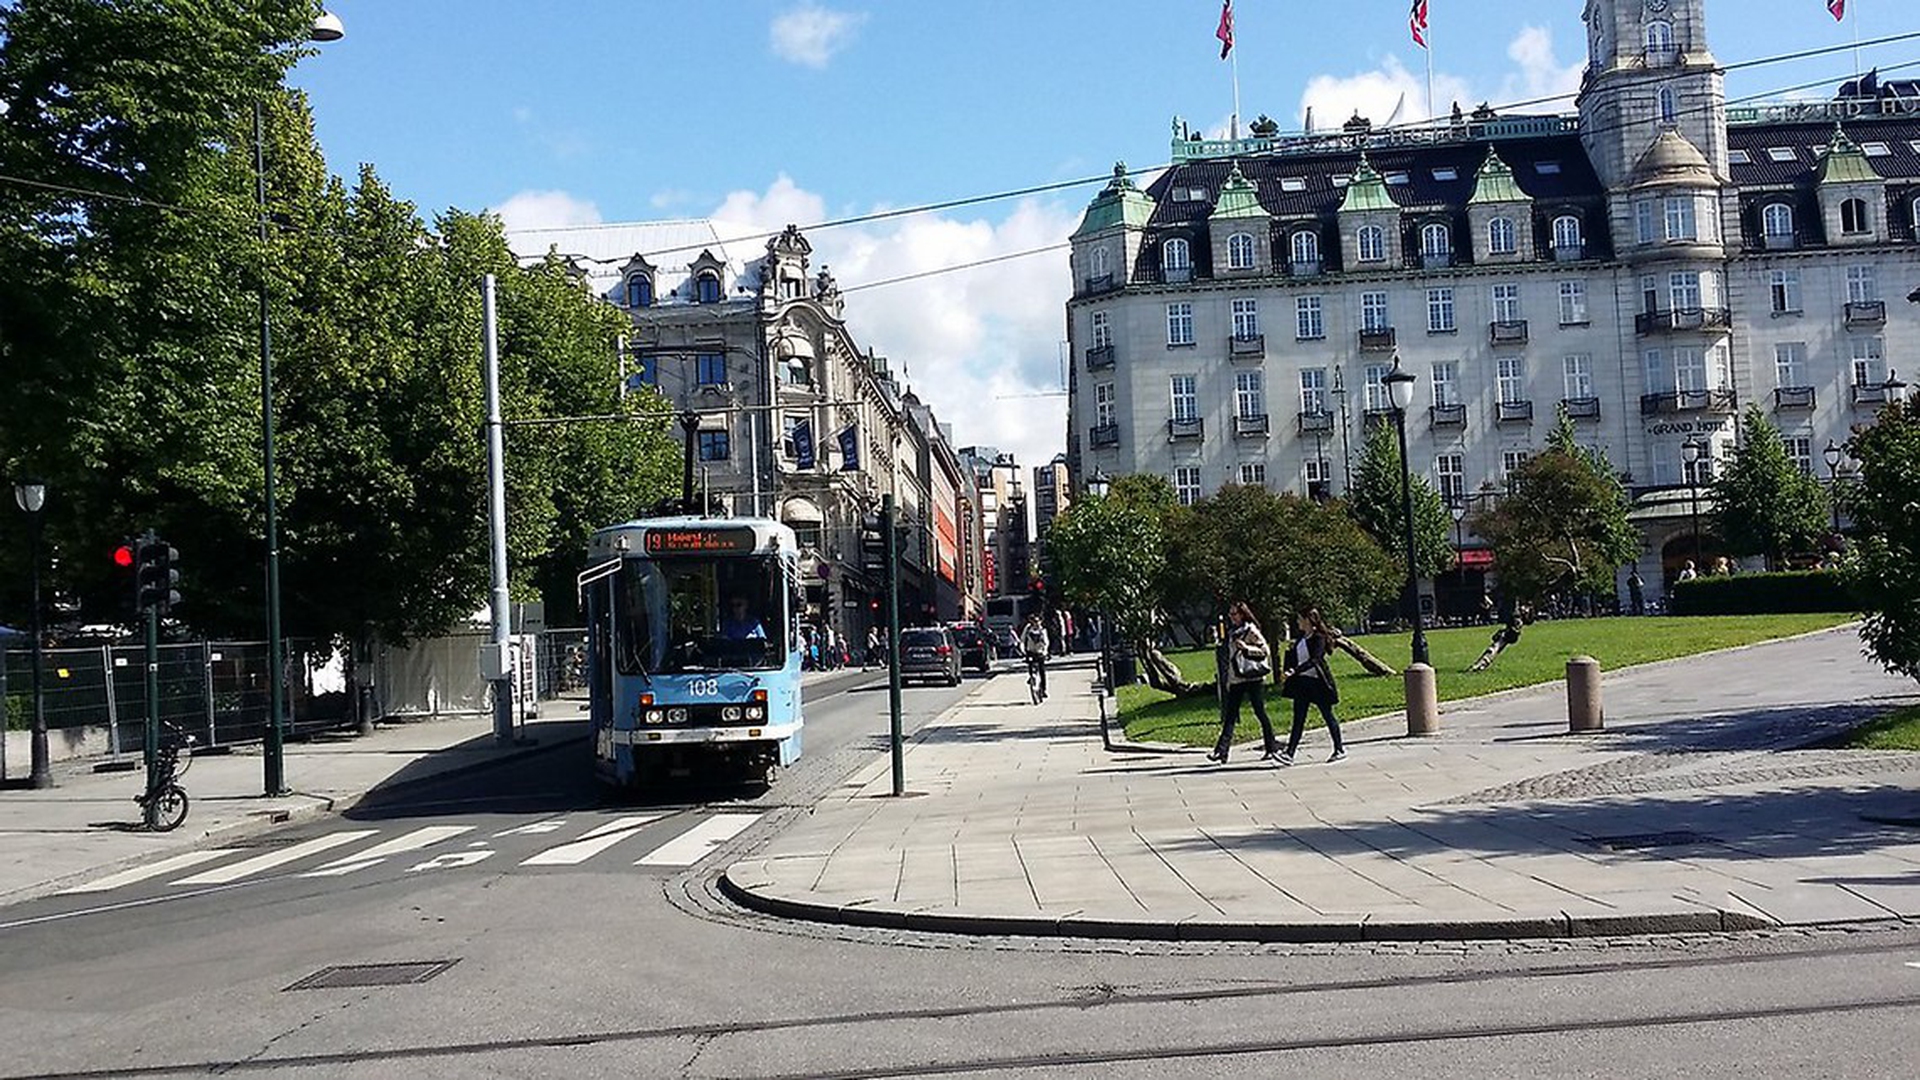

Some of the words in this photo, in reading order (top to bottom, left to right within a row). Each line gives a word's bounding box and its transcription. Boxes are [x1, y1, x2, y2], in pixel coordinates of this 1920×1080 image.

[1653, 422, 1693, 436] GRAND
[647, 533, 661, 551] 19
[984, 553, 994, 589] HOTEL
[687, 679, 718, 697] 108
